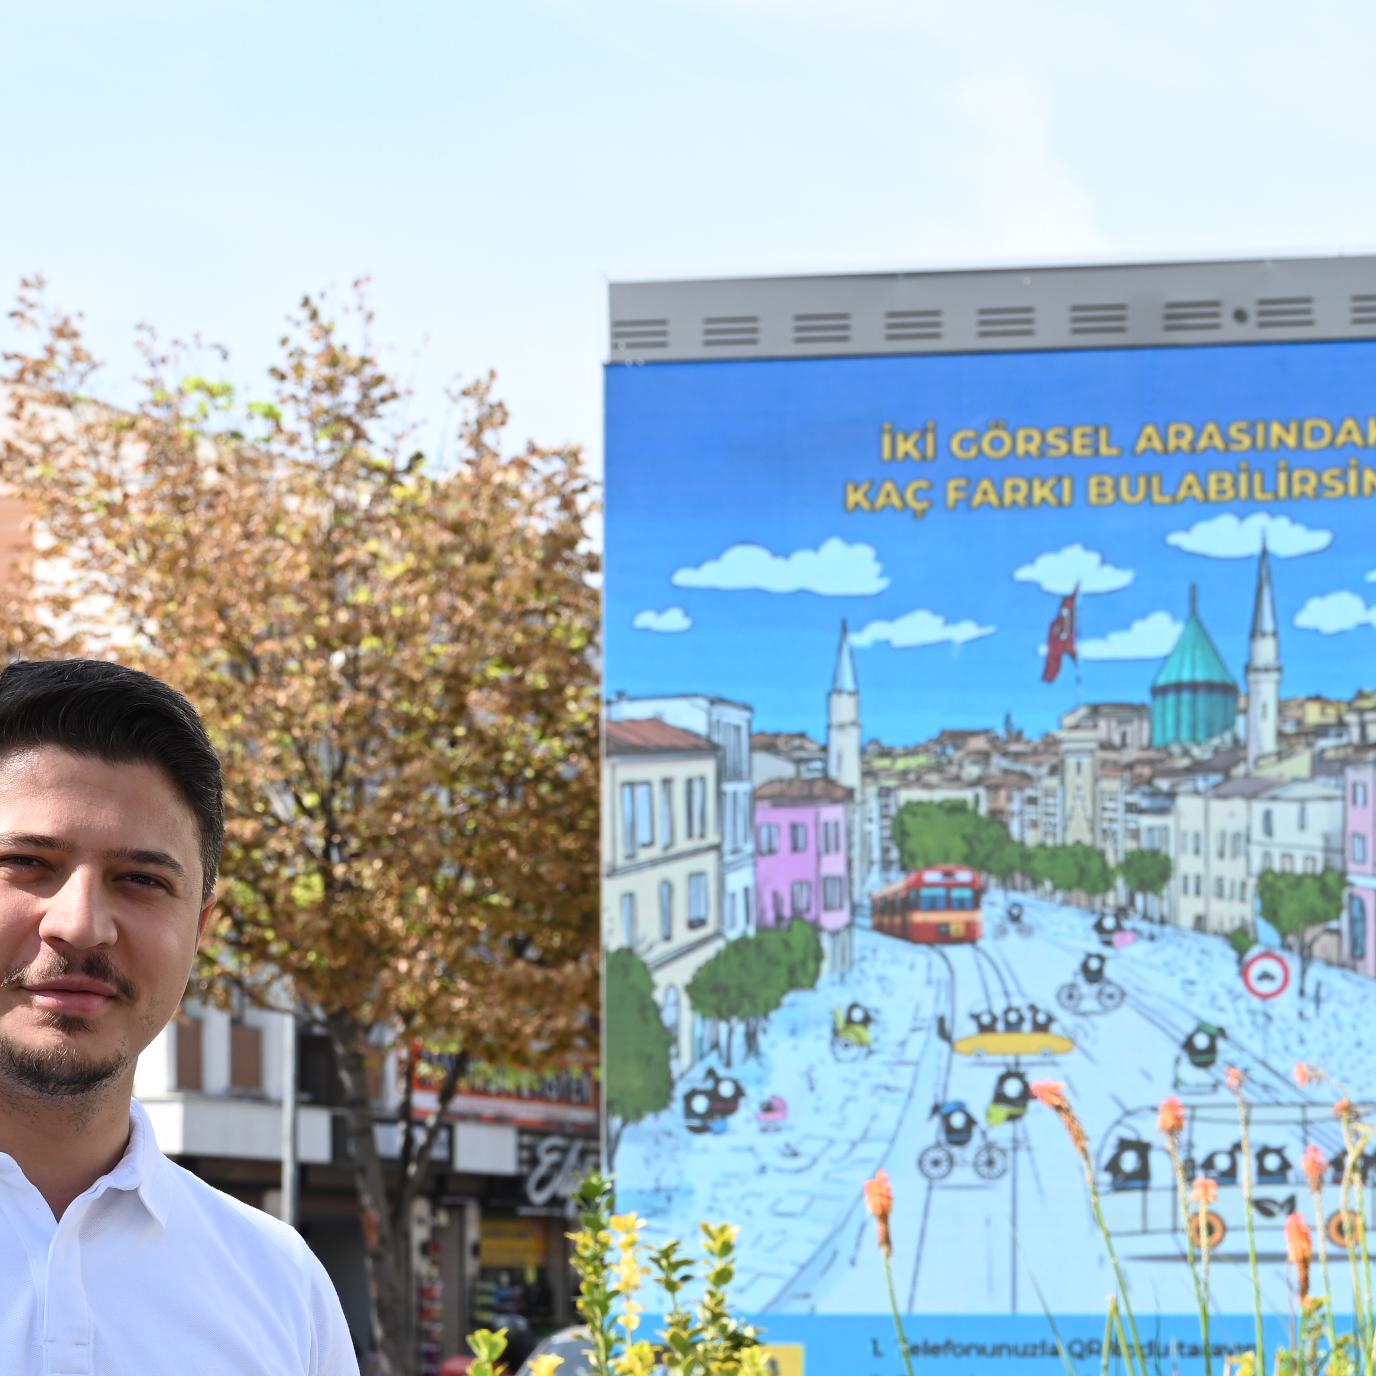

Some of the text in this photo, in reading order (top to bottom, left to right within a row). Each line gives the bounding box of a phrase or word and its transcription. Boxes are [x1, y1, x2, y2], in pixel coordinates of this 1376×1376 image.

[880, 420, 936, 462] İKİ
[949, 418, 1122, 460] GÖRSEL
[845, 479, 934, 520] KAÇ
[946, 474, 1072, 510] FARKI
[896, 1338, 1060, 1357] elefonunuzla
